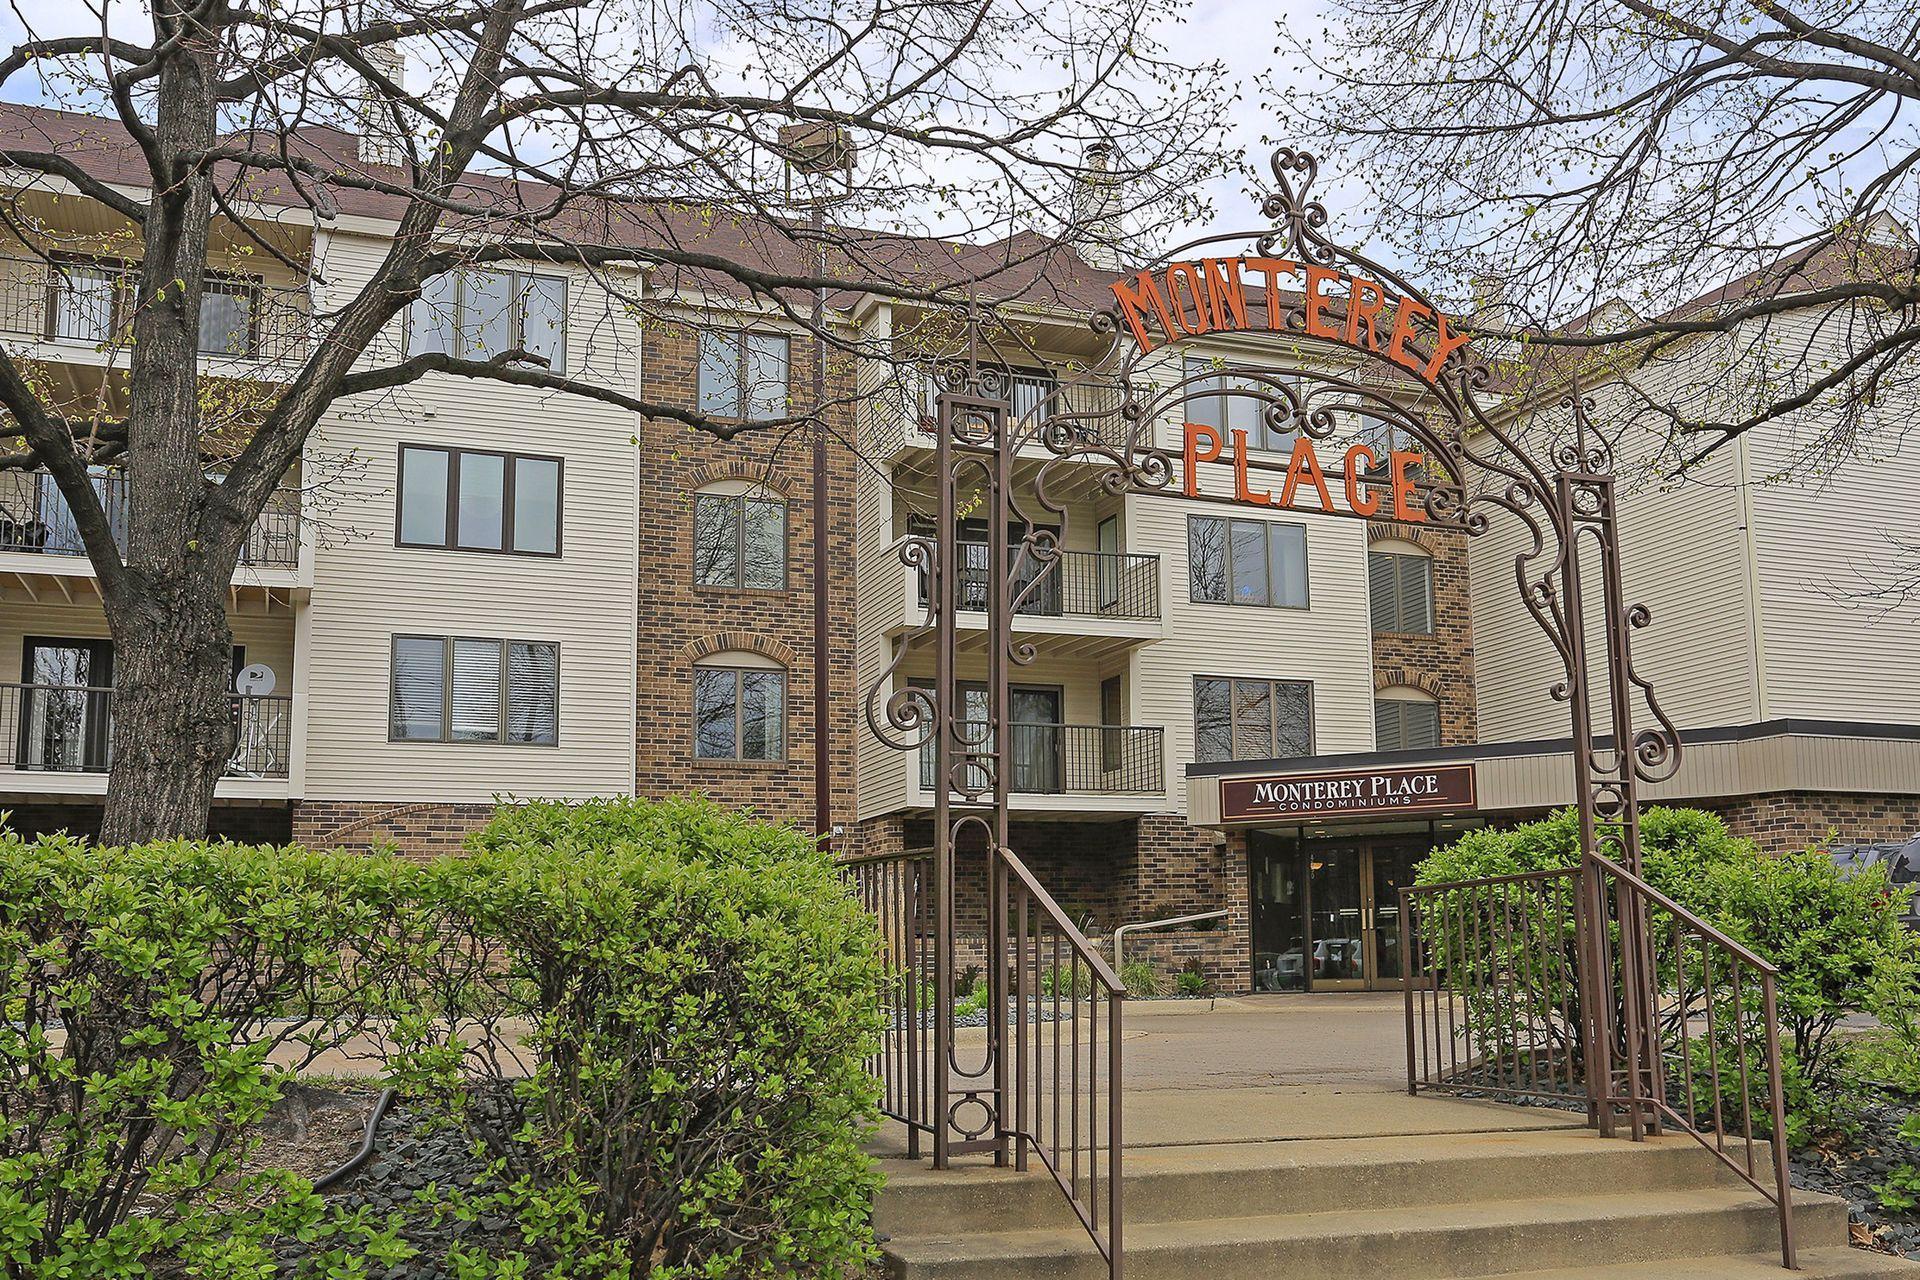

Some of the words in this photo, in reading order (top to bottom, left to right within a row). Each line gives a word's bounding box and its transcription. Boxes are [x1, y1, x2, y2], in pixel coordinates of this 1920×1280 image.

[1110, 258, 1471, 384] MONTEREY
[1184, 424, 1427, 521] PLACE
[1253, 779, 1366, 803] MONTEREY
[1371, 775, 1438, 796] PLACE
[1278, 796, 1411, 811] CONDOMINIUMS
